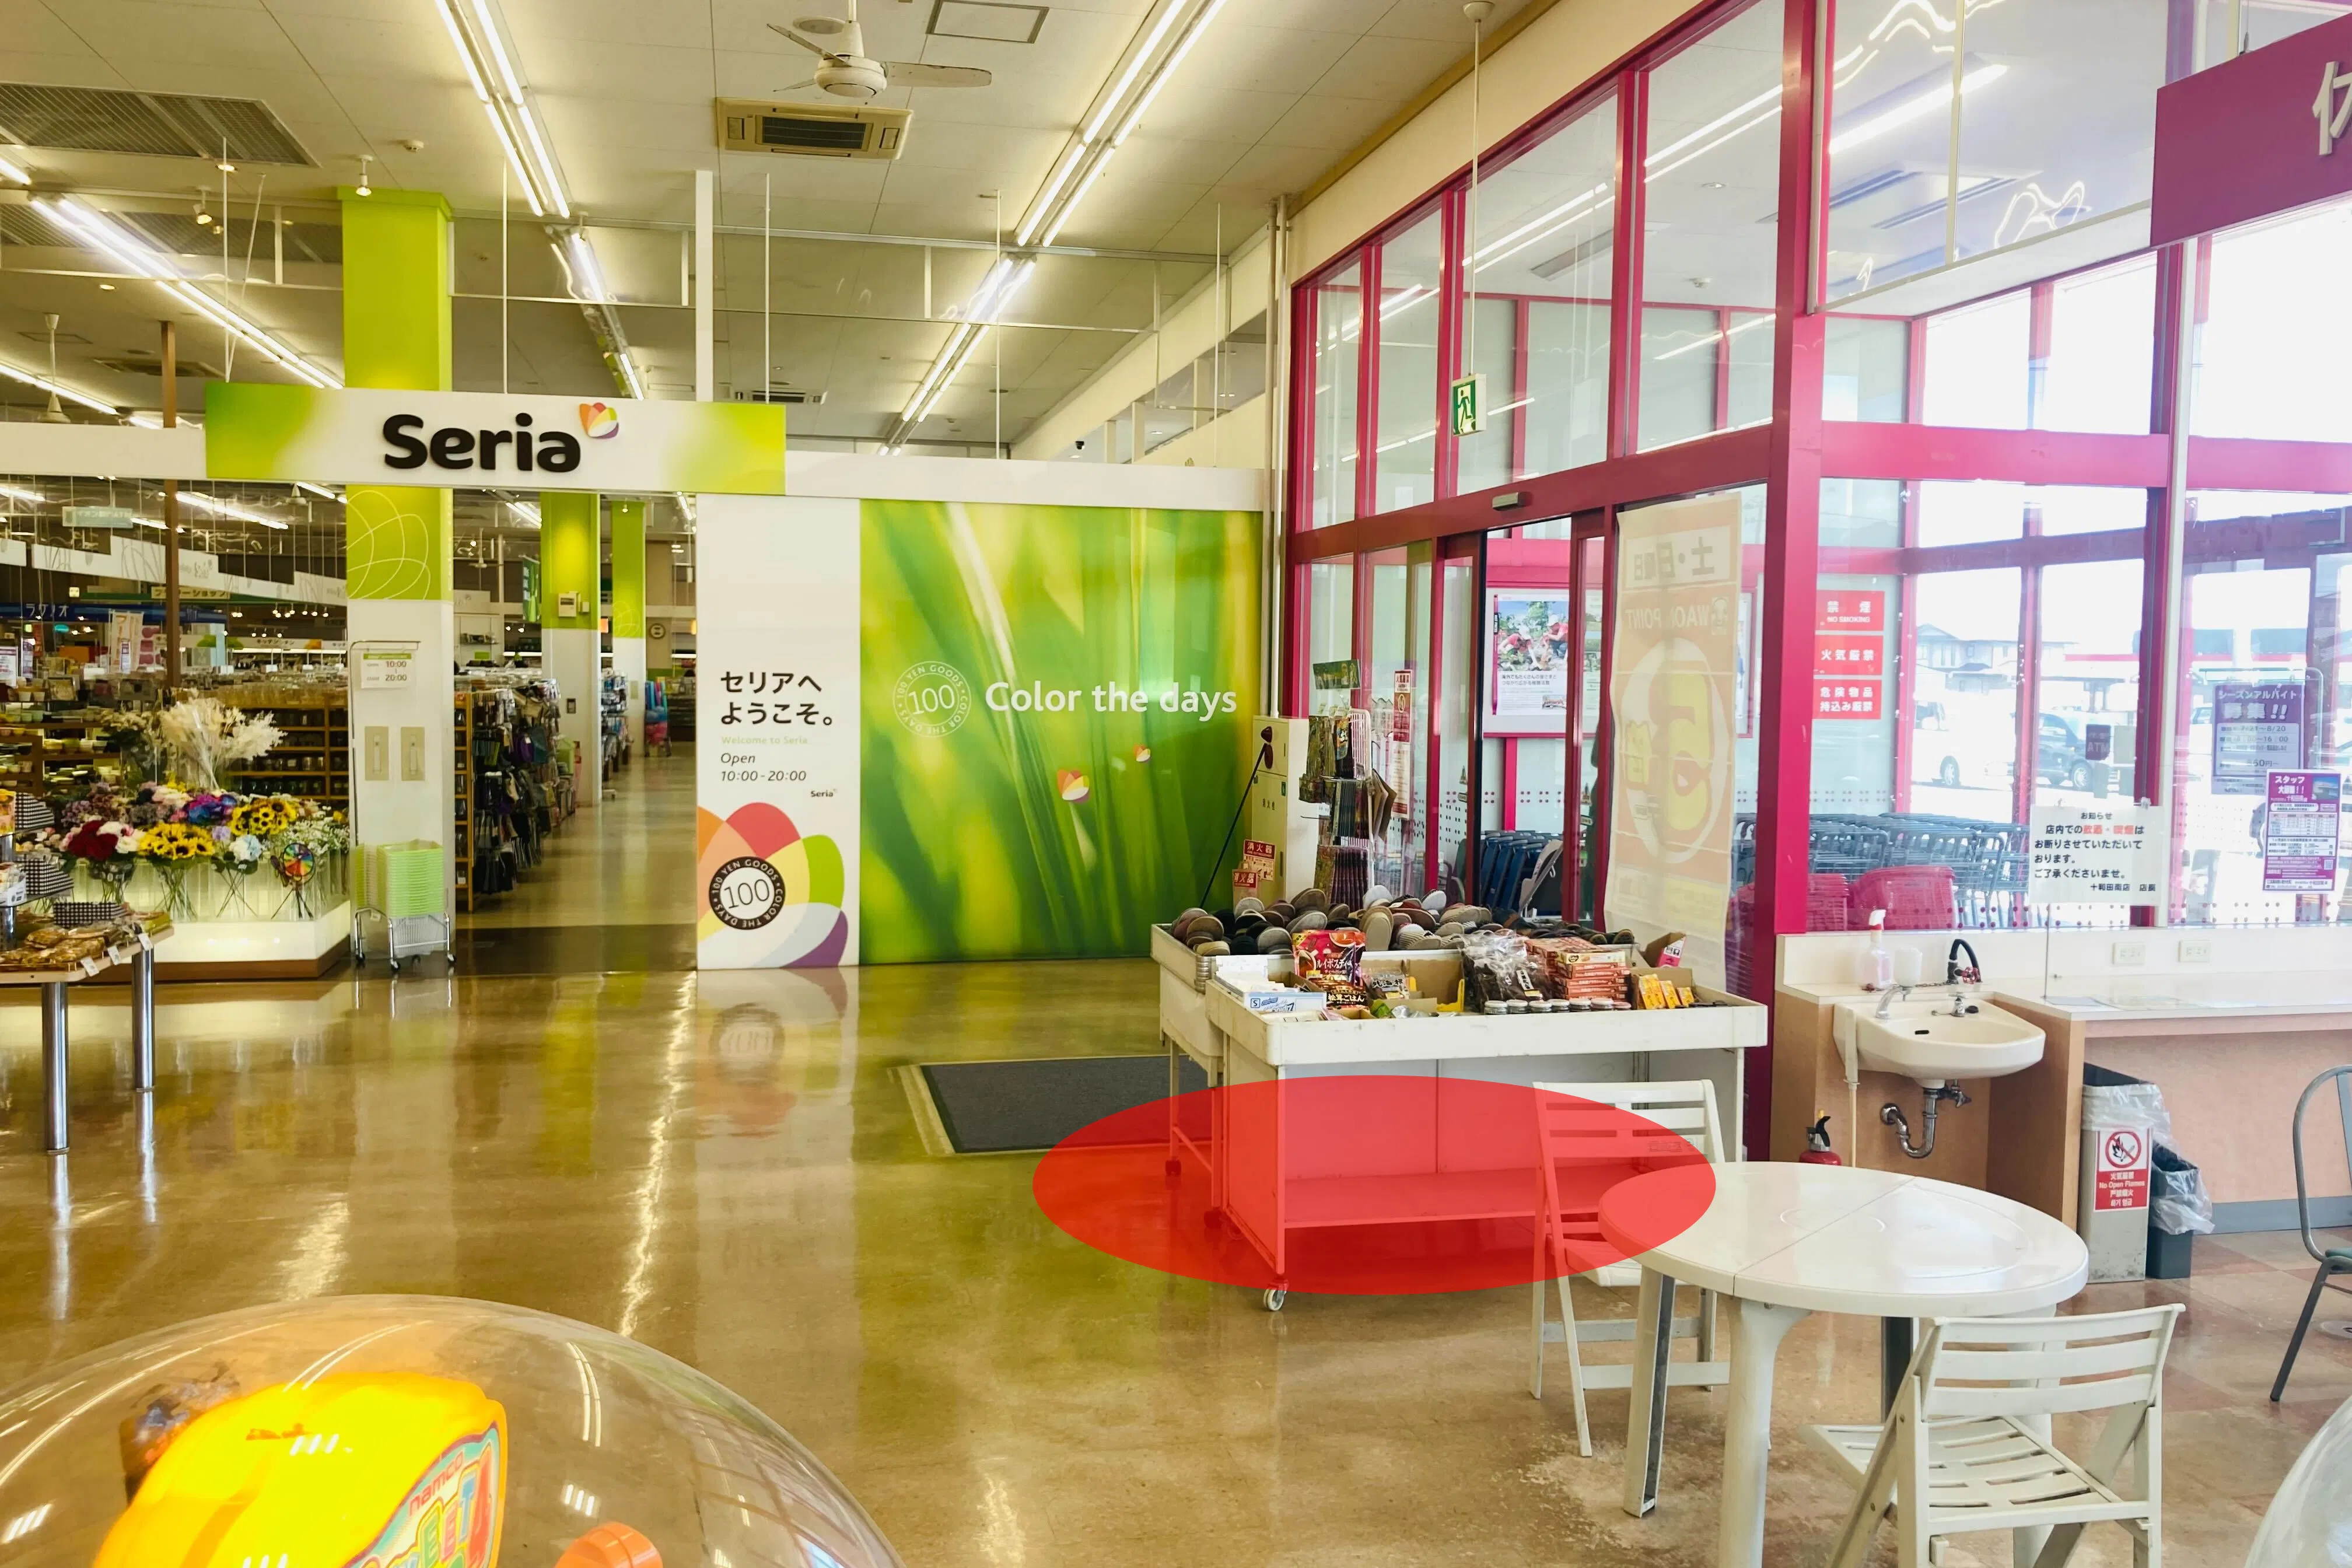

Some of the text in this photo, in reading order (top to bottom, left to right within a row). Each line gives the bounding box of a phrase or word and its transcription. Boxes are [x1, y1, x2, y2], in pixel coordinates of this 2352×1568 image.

[383, 412, 581, 473] Seria
[1821, 649, 1874, 661] 火気厳禁
[906, 666, 926, 680] YEN
[929, 664, 964, 687] GOODS
[720, 671, 822, 694] セリアへ
[908, 684, 956, 715] 100
[1820, 687, 1873, 698] 危険物品
[2218, 688, 2297, 700] シーズンアルバイト
[985, 681, 1237, 722] Color the days
[721, 702, 834, 727] ようこそ。
[948, 696, 968, 728] COLOR
[900, 709, 923, 732] DAYS
[926, 726, 947, 734] THE
[722, 736, 808, 745] Welcome to Seria
[720, 752, 756, 766] Open
[2274, 775, 2305, 784] スタッフ
[810, 789, 835, 797] Seria
[1247, 842, 1272, 854] 消火器
[2034, 840, 2143, 849] お断りさせていただいて
[2034, 854, 2077, 864] おります。
[721, 860, 741, 875] YEN
[744, 859, 779, 881] GOODS
[2034, 869, 2126, 878] ご了承くださいませ。
[724, 878, 770, 909] 100
[764, 888, 783, 920] COLOR
[715, 904, 738, 926] DAYS
[741, 919, 762, 928] THE
[2108, 1181, 2124, 1189] Open
[408, 1450, 464, 1517] namco
